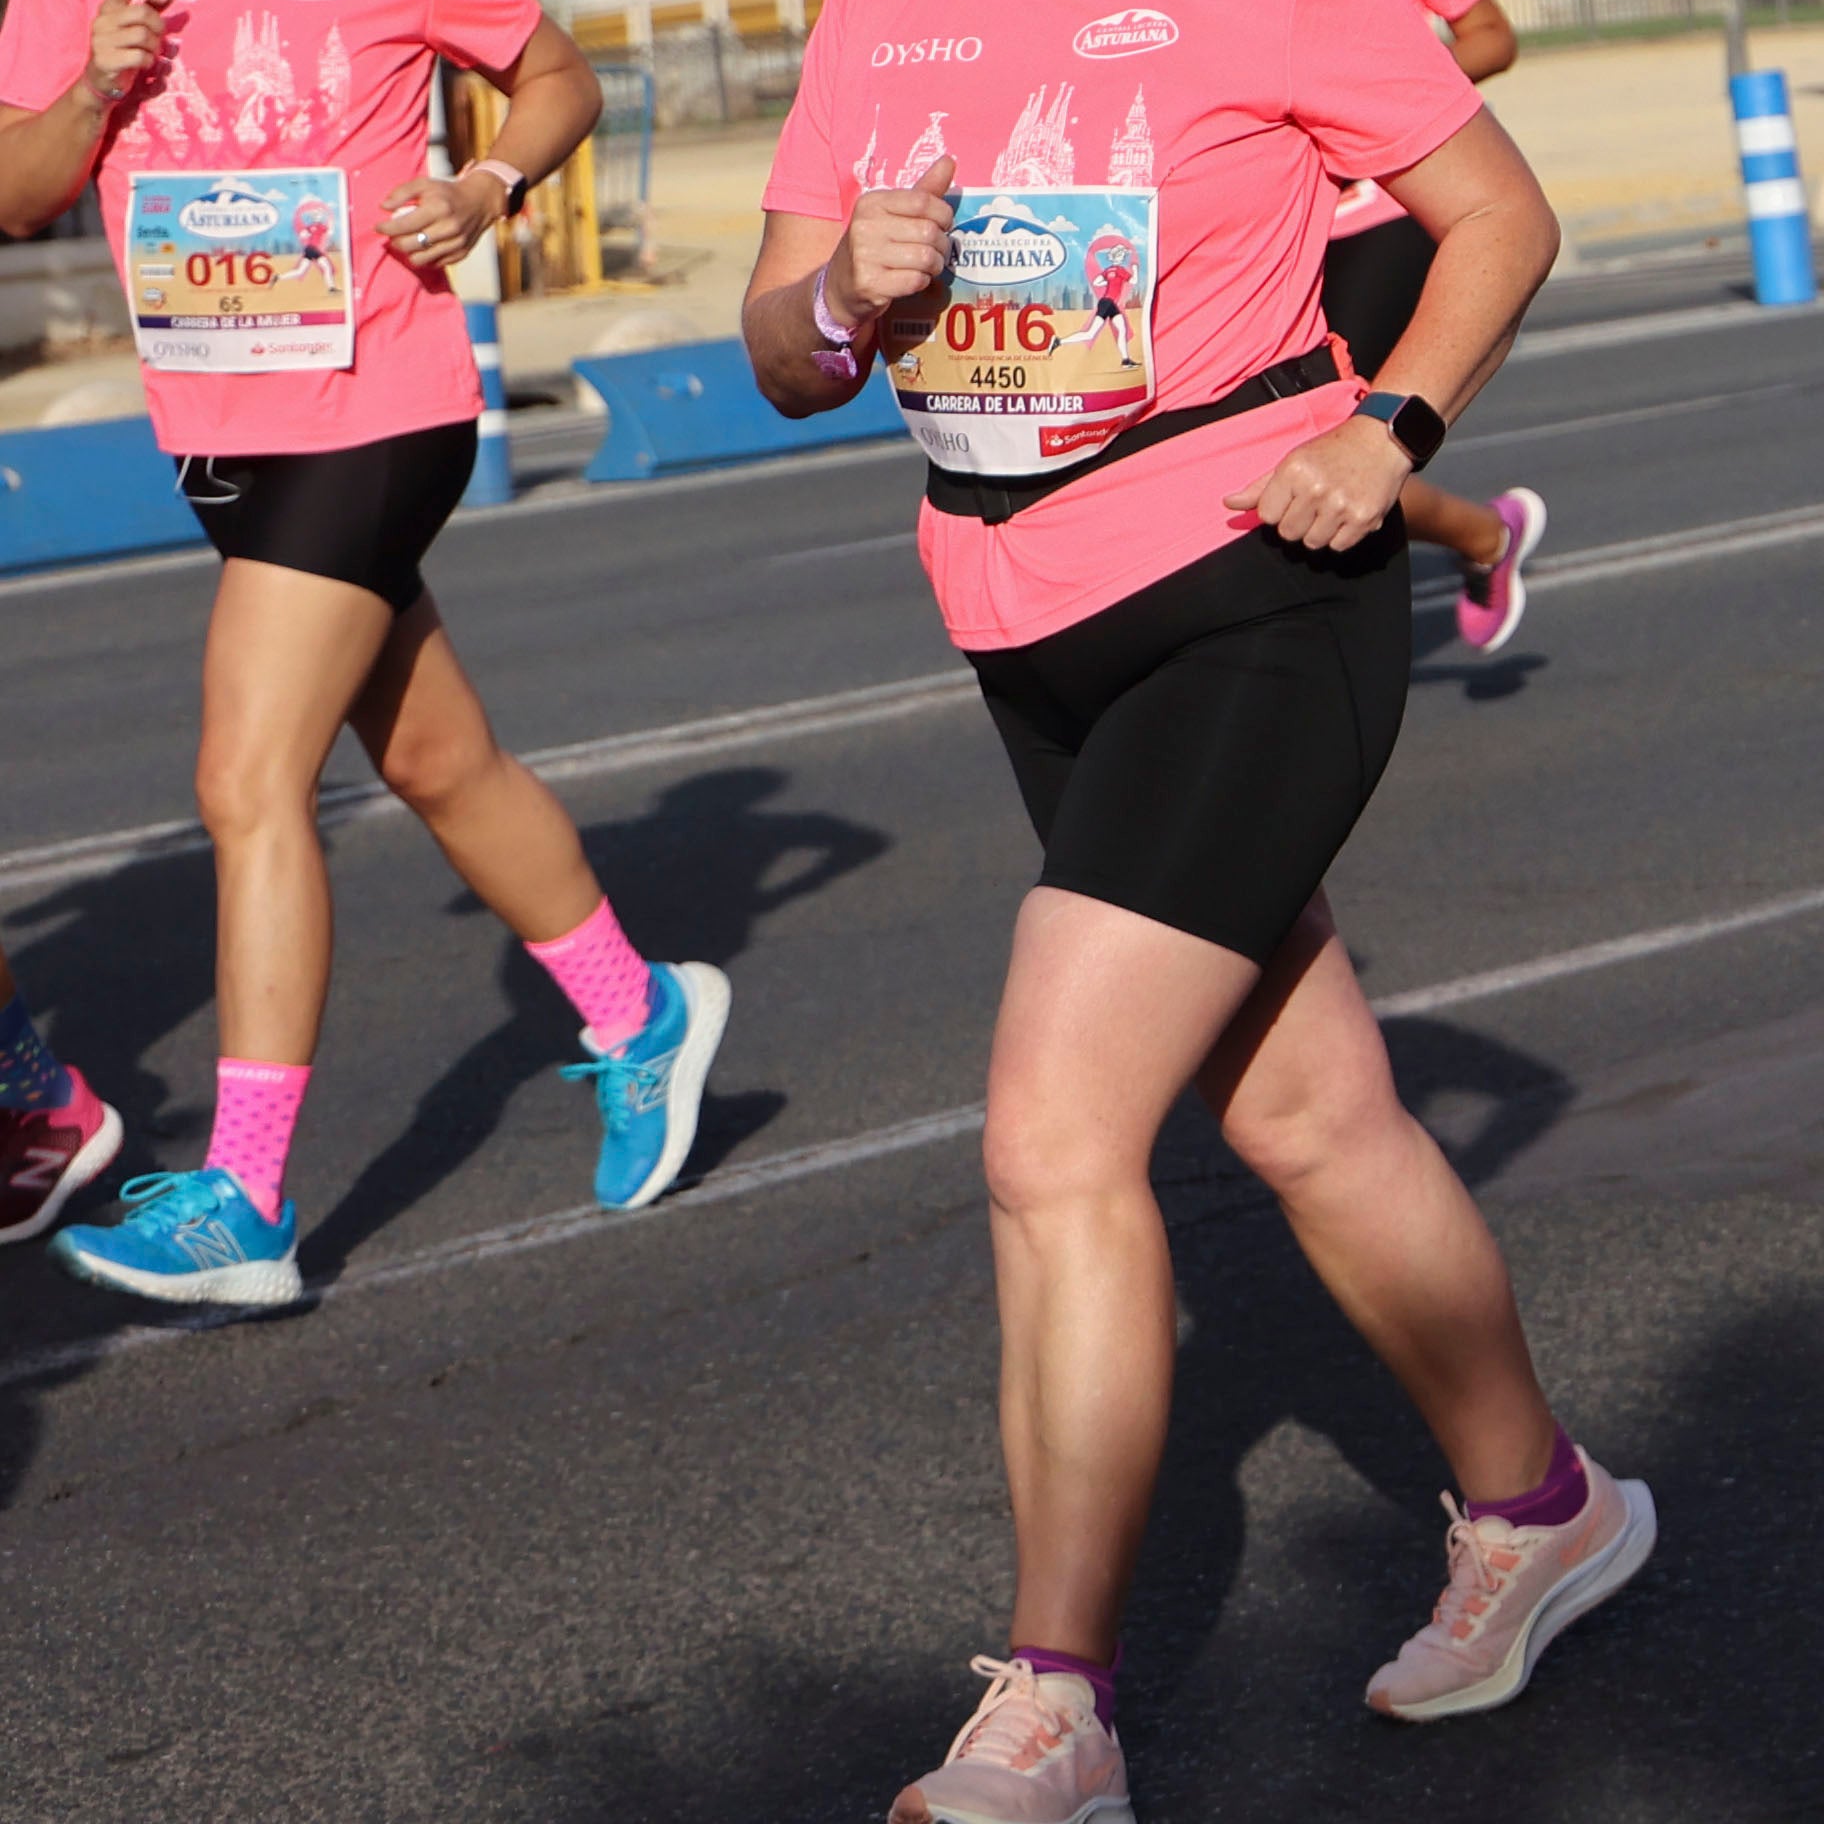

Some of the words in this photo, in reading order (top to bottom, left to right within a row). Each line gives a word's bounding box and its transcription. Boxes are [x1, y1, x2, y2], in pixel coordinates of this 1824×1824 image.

[871, 36, 983, 68] OYSHO
[1079, 29, 1169, 51] ASTURIANA
[948, 240, 1057, 268] ASTURIANA
[185, 251, 275, 287] 016
[218, 295, 244, 313] 65
[945, 302, 1057, 353] 016
[969, 365, 1027, 389] 4450
[926, 394, 981, 412] CARRERA
[985, 395, 1003, 412] DE
[1007, 395, 1026, 412] LA
[1029, 395, 1084, 412] MUJER
